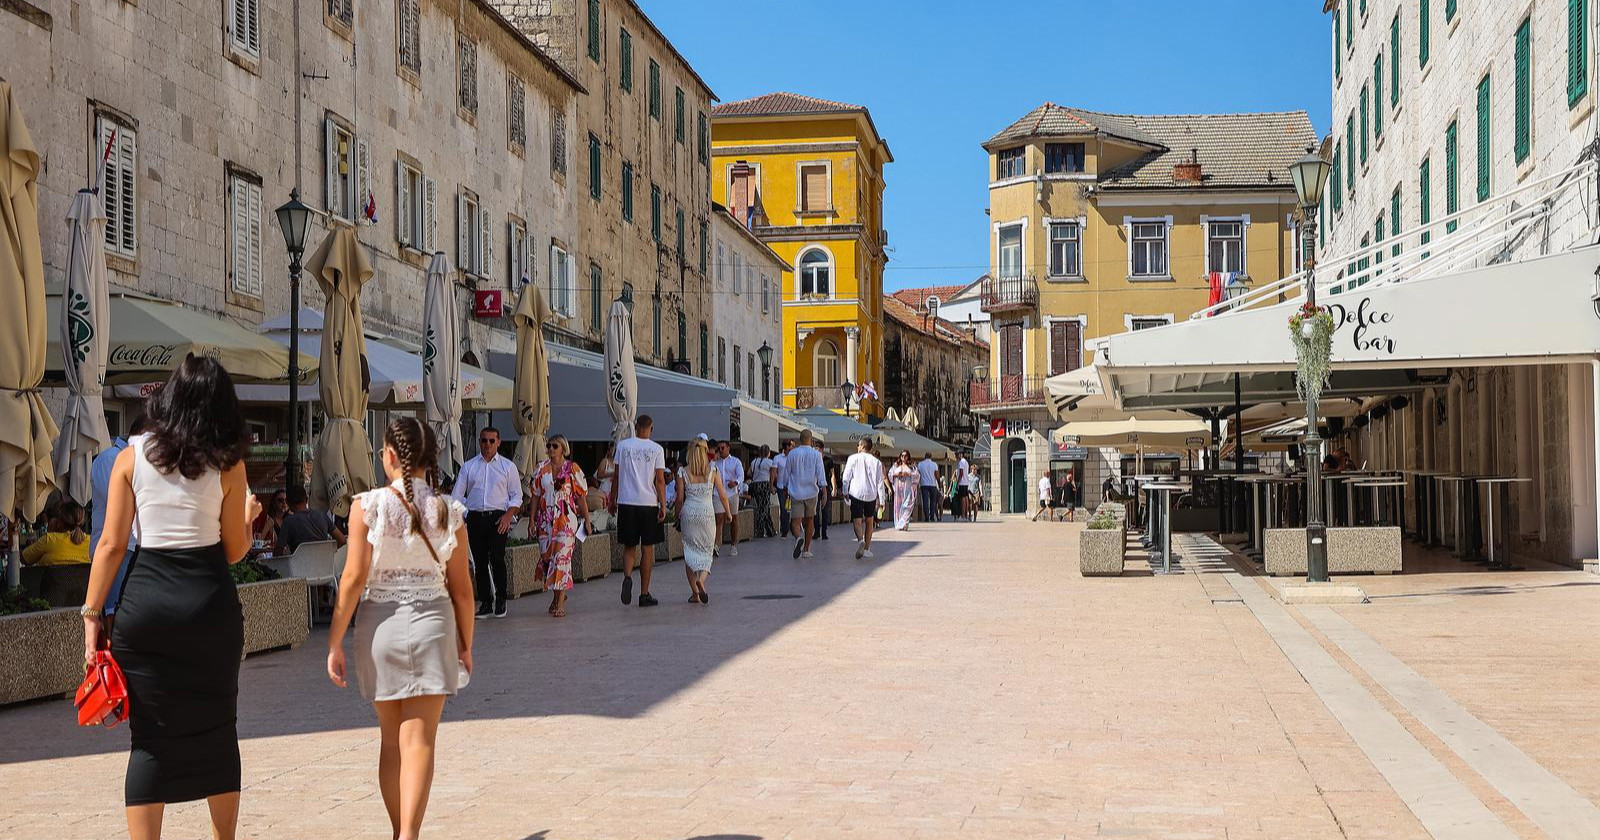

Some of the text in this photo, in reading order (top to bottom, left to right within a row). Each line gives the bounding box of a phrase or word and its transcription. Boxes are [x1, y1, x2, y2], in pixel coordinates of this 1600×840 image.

[1322, 297, 1394, 331] Dolce
[1353, 325, 1397, 354] bar
[109, 344, 177, 366] Coca-Cola
[1006, 419, 1031, 432] HPB
